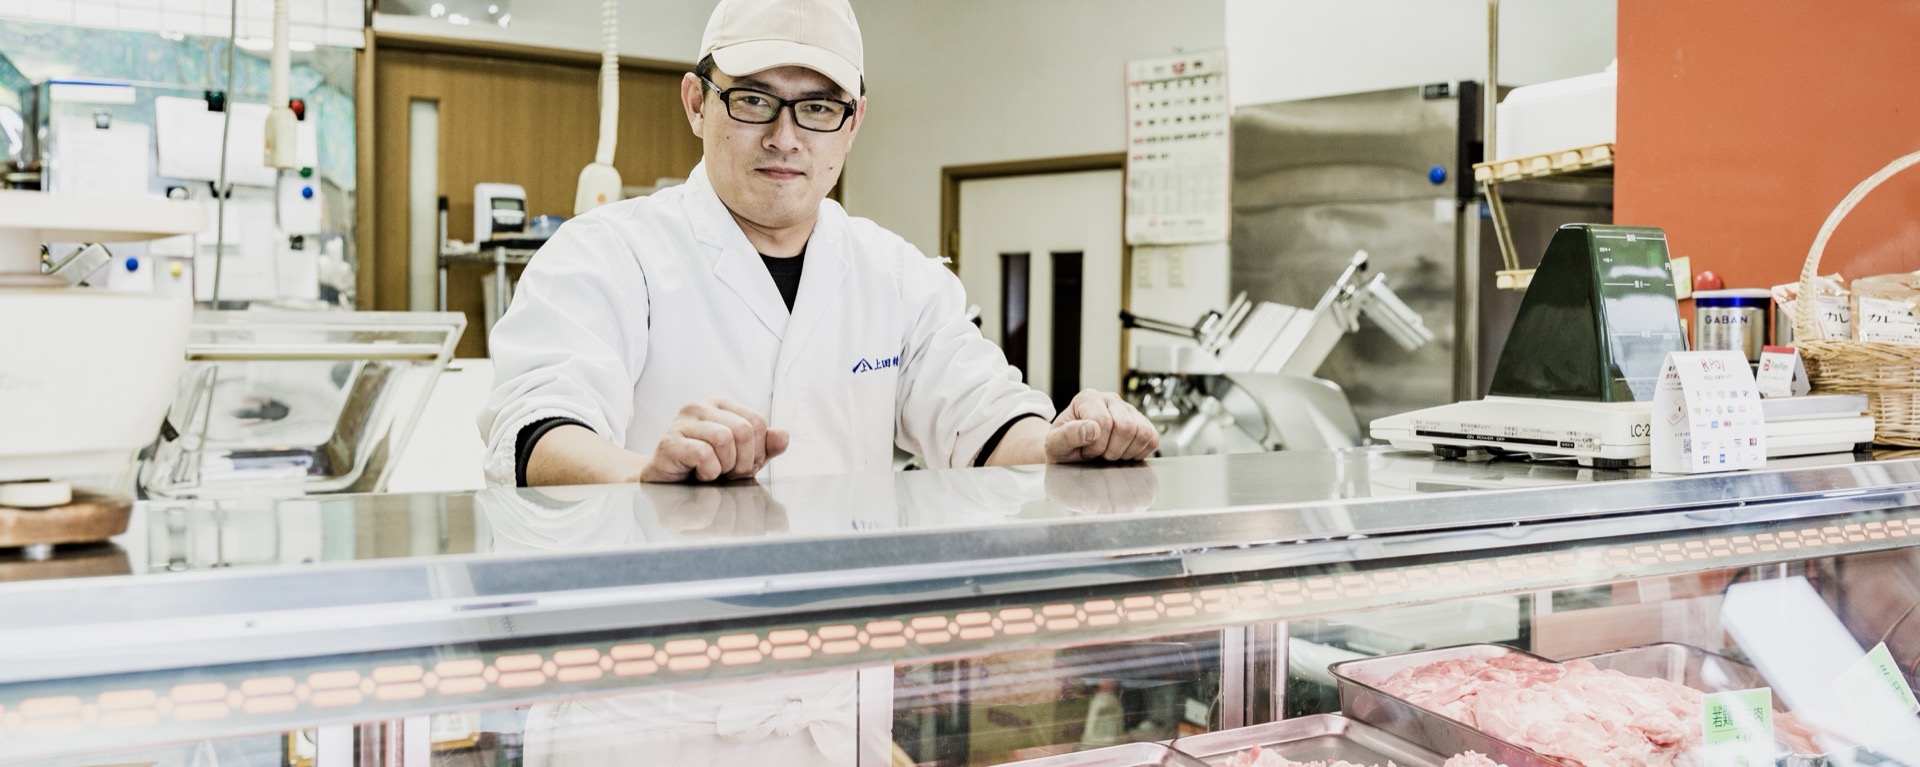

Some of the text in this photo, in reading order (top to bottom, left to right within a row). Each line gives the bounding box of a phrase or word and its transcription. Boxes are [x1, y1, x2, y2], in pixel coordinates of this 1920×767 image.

[1704, 315, 1748, 324] GABAN
[1867, 313, 1915, 324] カレー
